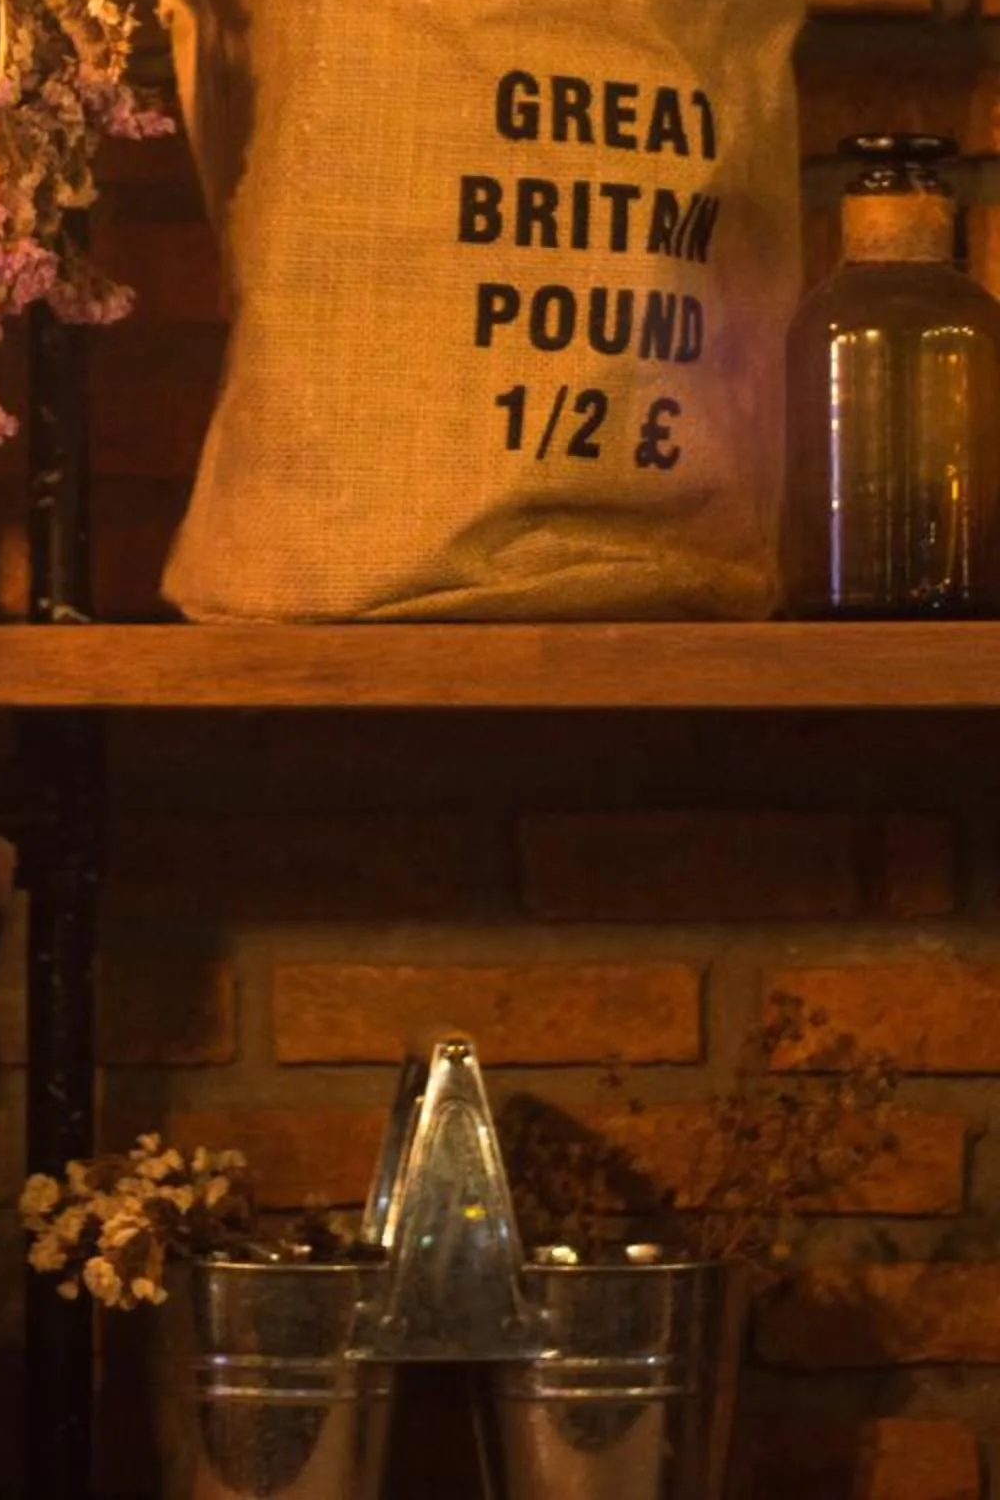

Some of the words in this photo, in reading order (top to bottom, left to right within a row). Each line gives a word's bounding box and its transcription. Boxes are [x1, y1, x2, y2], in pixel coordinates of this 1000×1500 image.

[474, 282, 704, 363] POUND
[495, 384, 609, 460] 1/2
[634, 397, 682, 470] £
